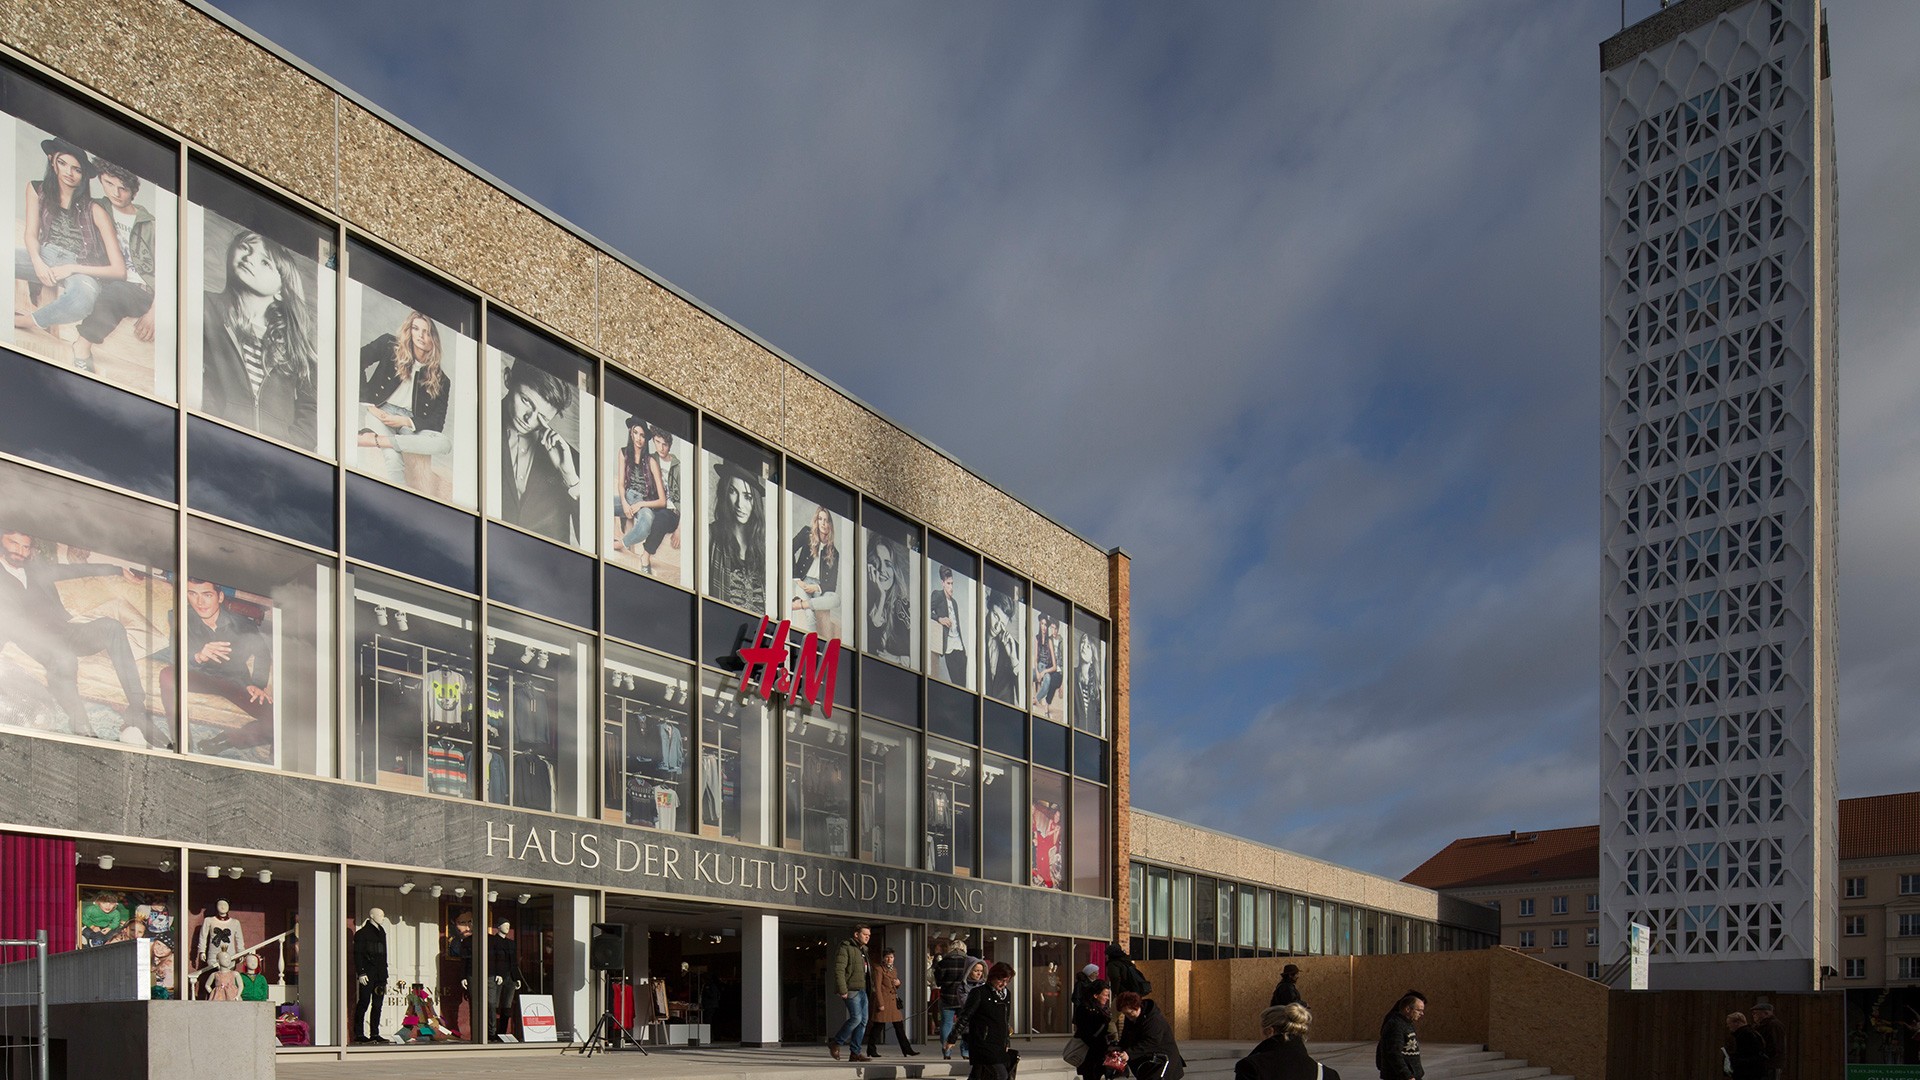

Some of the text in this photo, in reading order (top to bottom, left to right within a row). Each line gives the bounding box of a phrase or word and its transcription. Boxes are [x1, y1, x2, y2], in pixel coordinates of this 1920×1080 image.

[736, 614, 842, 719] H&M
[485, 820, 984, 914] HAUS DER KULTUR UND BILDUNG
